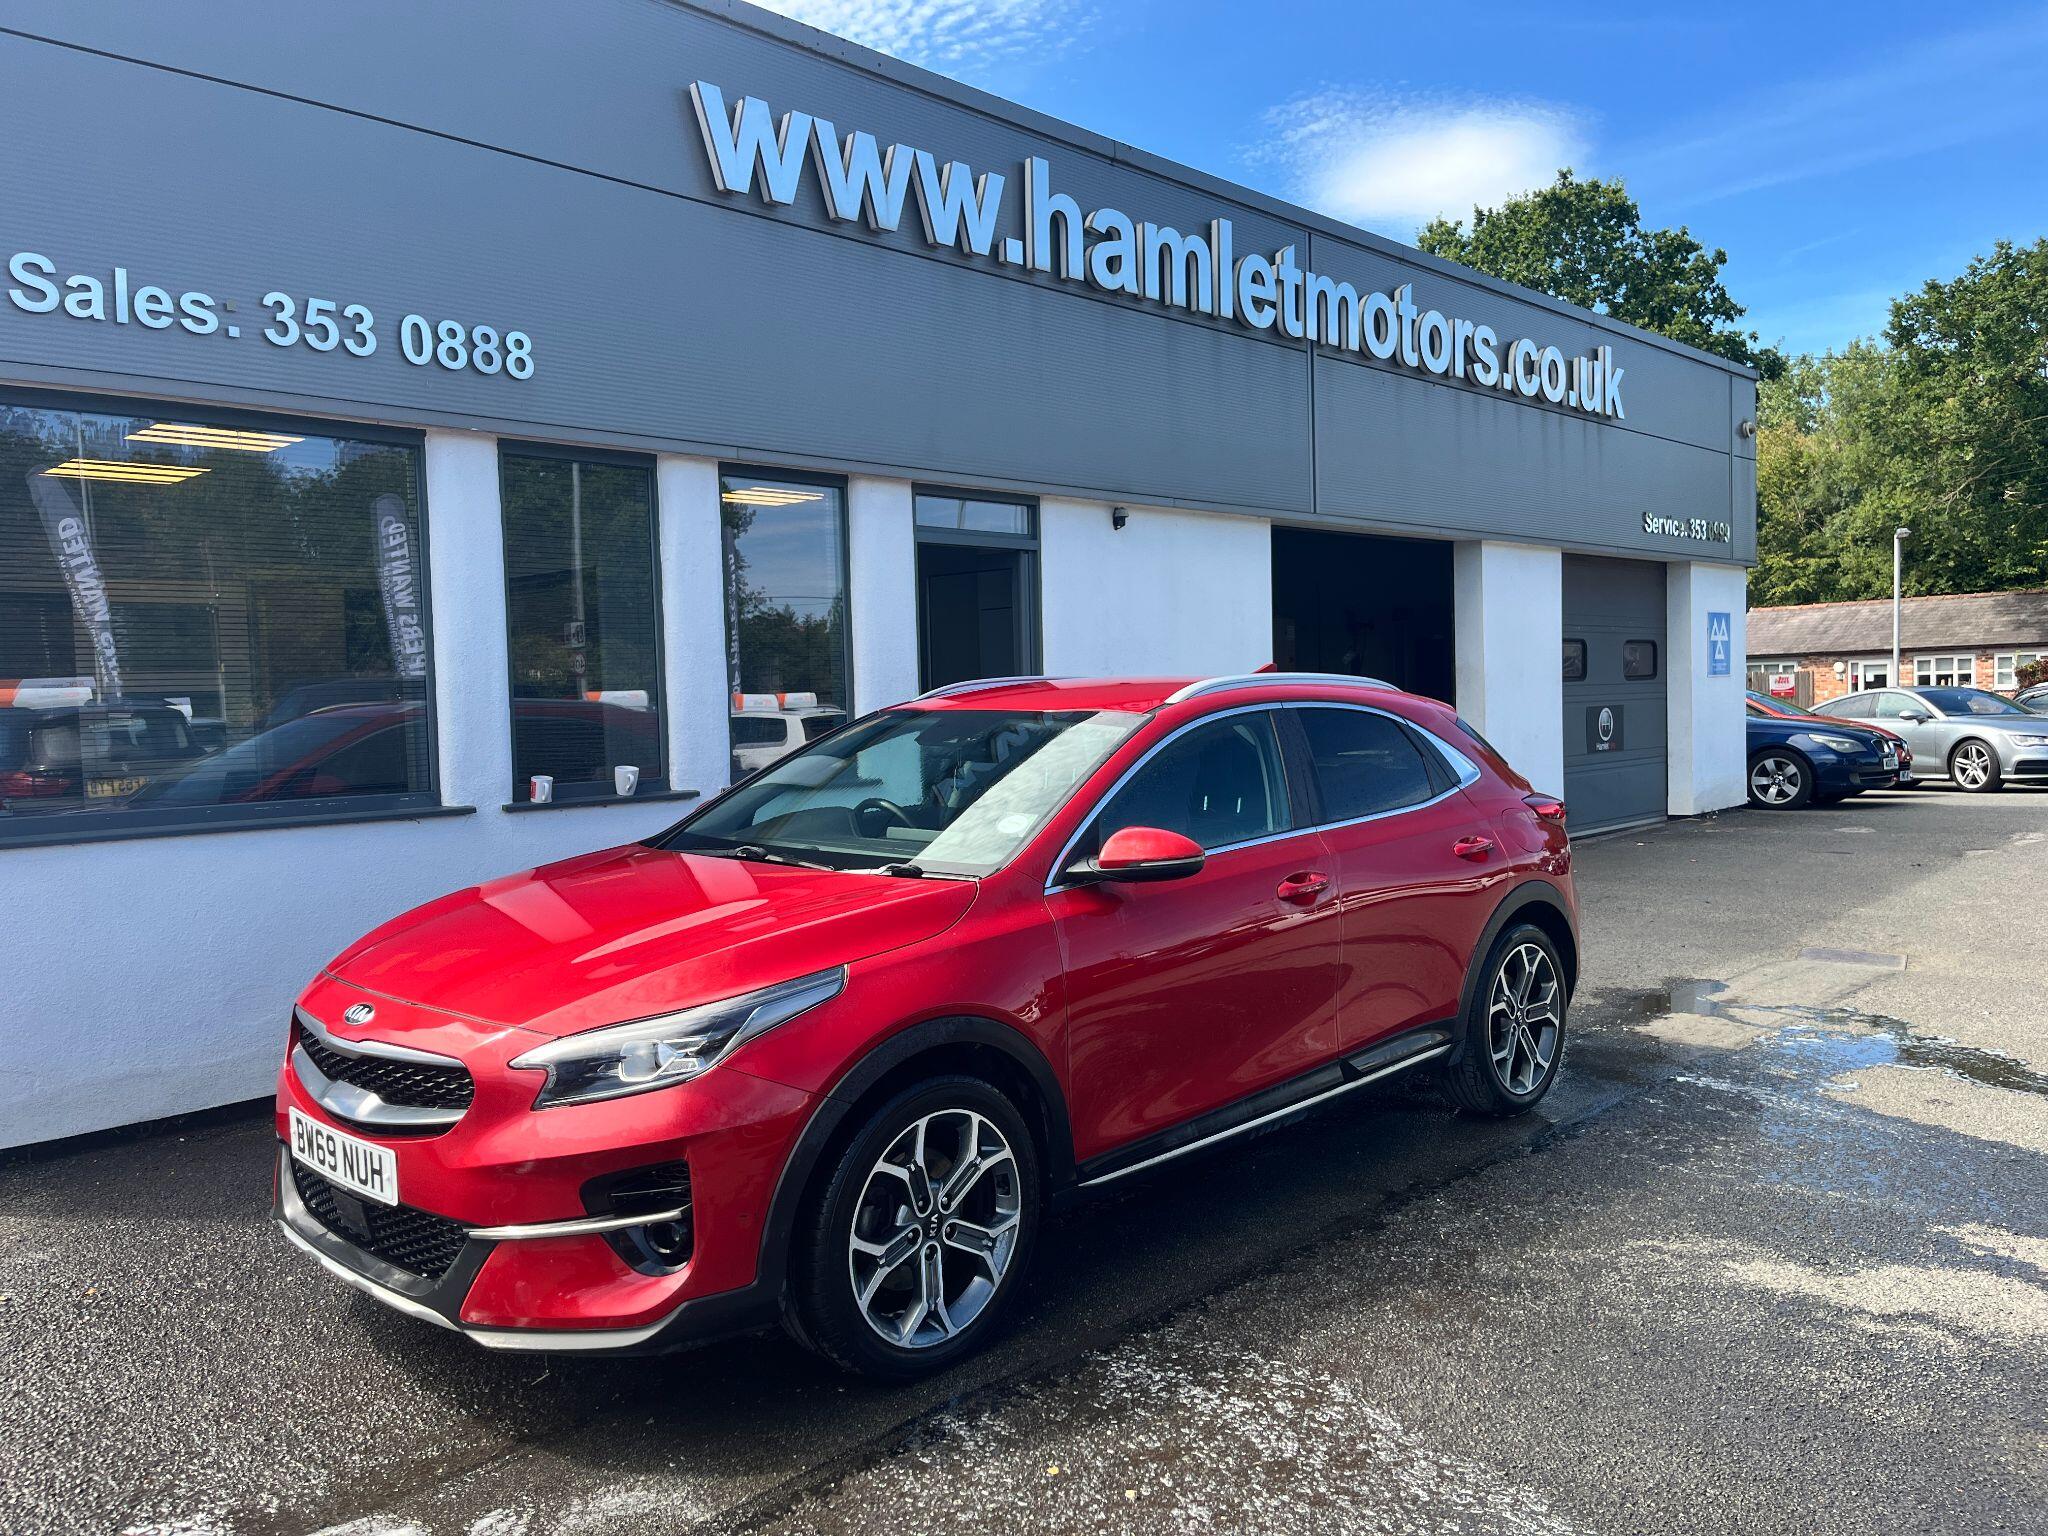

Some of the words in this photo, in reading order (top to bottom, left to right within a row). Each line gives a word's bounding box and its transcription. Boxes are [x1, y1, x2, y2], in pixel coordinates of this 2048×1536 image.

[689, 80, 1626, 420] www.hamletmotors.co.uk
[262, 291, 378, 358] 353
[400, 313, 536, 381] 0888
[1689, 518, 1707, 541] 353
[346, 1004, 373, 1023] KIA
[295, 1115, 338, 1174] BW69
[342, 1139, 385, 1194] NUH
